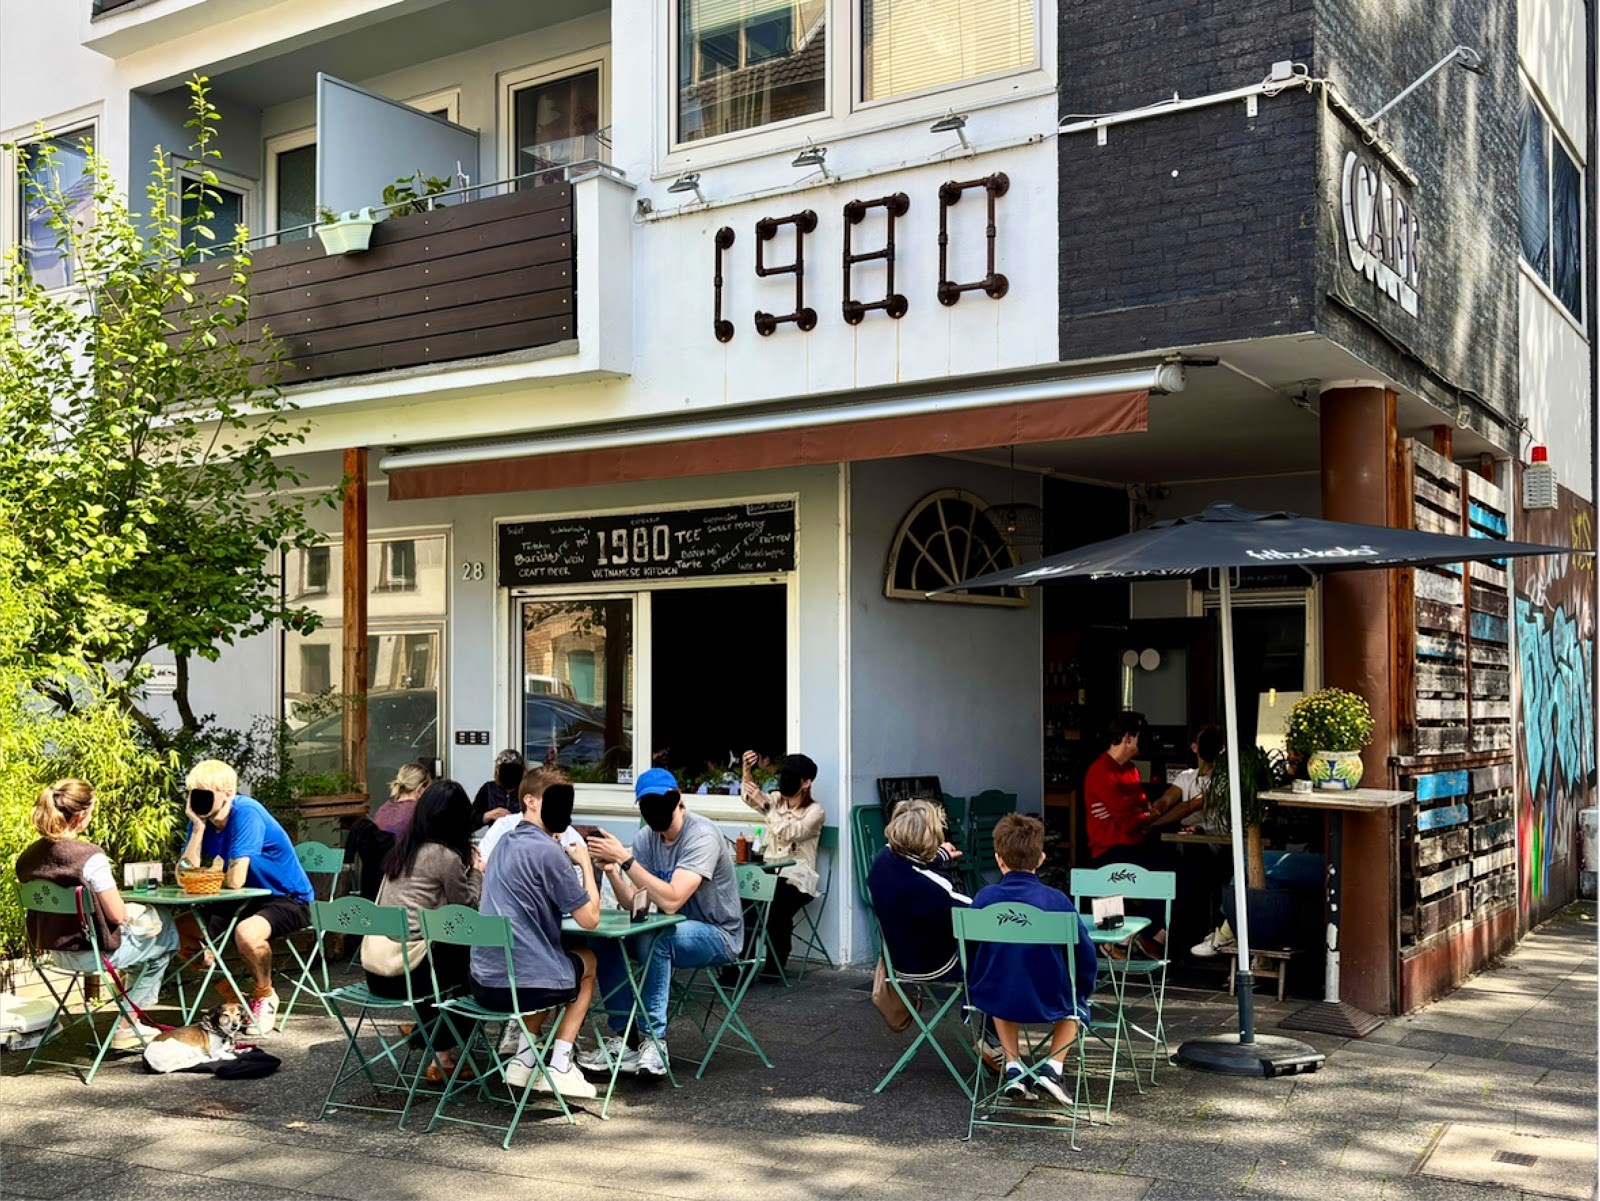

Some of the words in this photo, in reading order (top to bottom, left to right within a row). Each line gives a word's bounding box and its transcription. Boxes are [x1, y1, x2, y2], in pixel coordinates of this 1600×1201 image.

[714, 171, 1010, 343] 1980
[597, 525, 670, 566] 1980
[462, 562, 483, 580] 28
